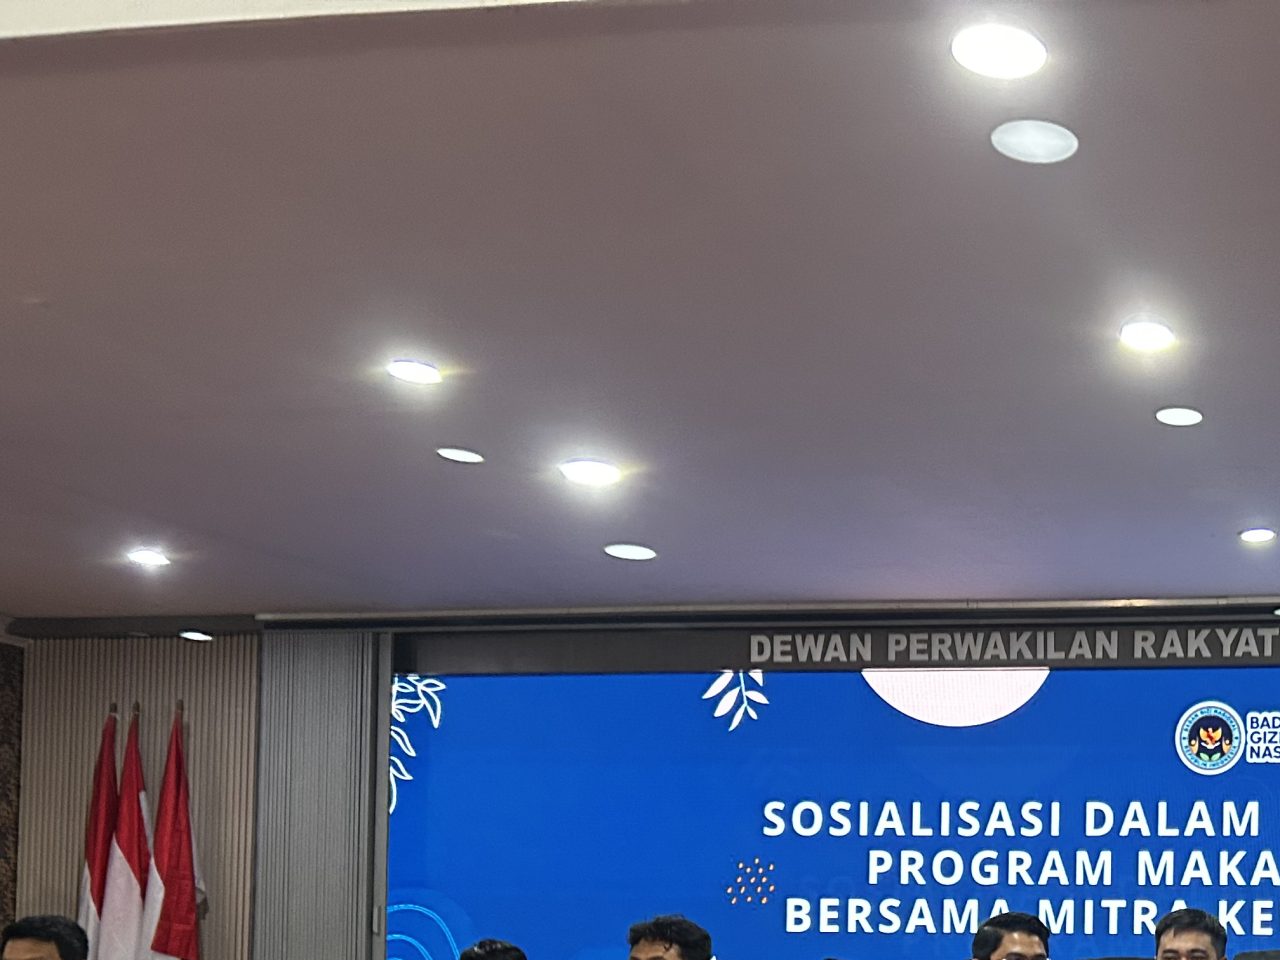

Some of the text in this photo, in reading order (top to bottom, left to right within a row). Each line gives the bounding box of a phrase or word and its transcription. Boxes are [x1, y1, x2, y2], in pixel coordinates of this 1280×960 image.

[749, 633, 872, 663] DEWAN
[887, 630, 1118, 662] PERWAKILAN
[1133, 627, 1280, 659] RAKYAT
[763, 801, 1060, 836] SOSIALISASI
[1085, 801, 1259, 836] DALAM
[868, 849, 1112, 886] PROGRAM
[1038, 899, 1188, 936] MITR
